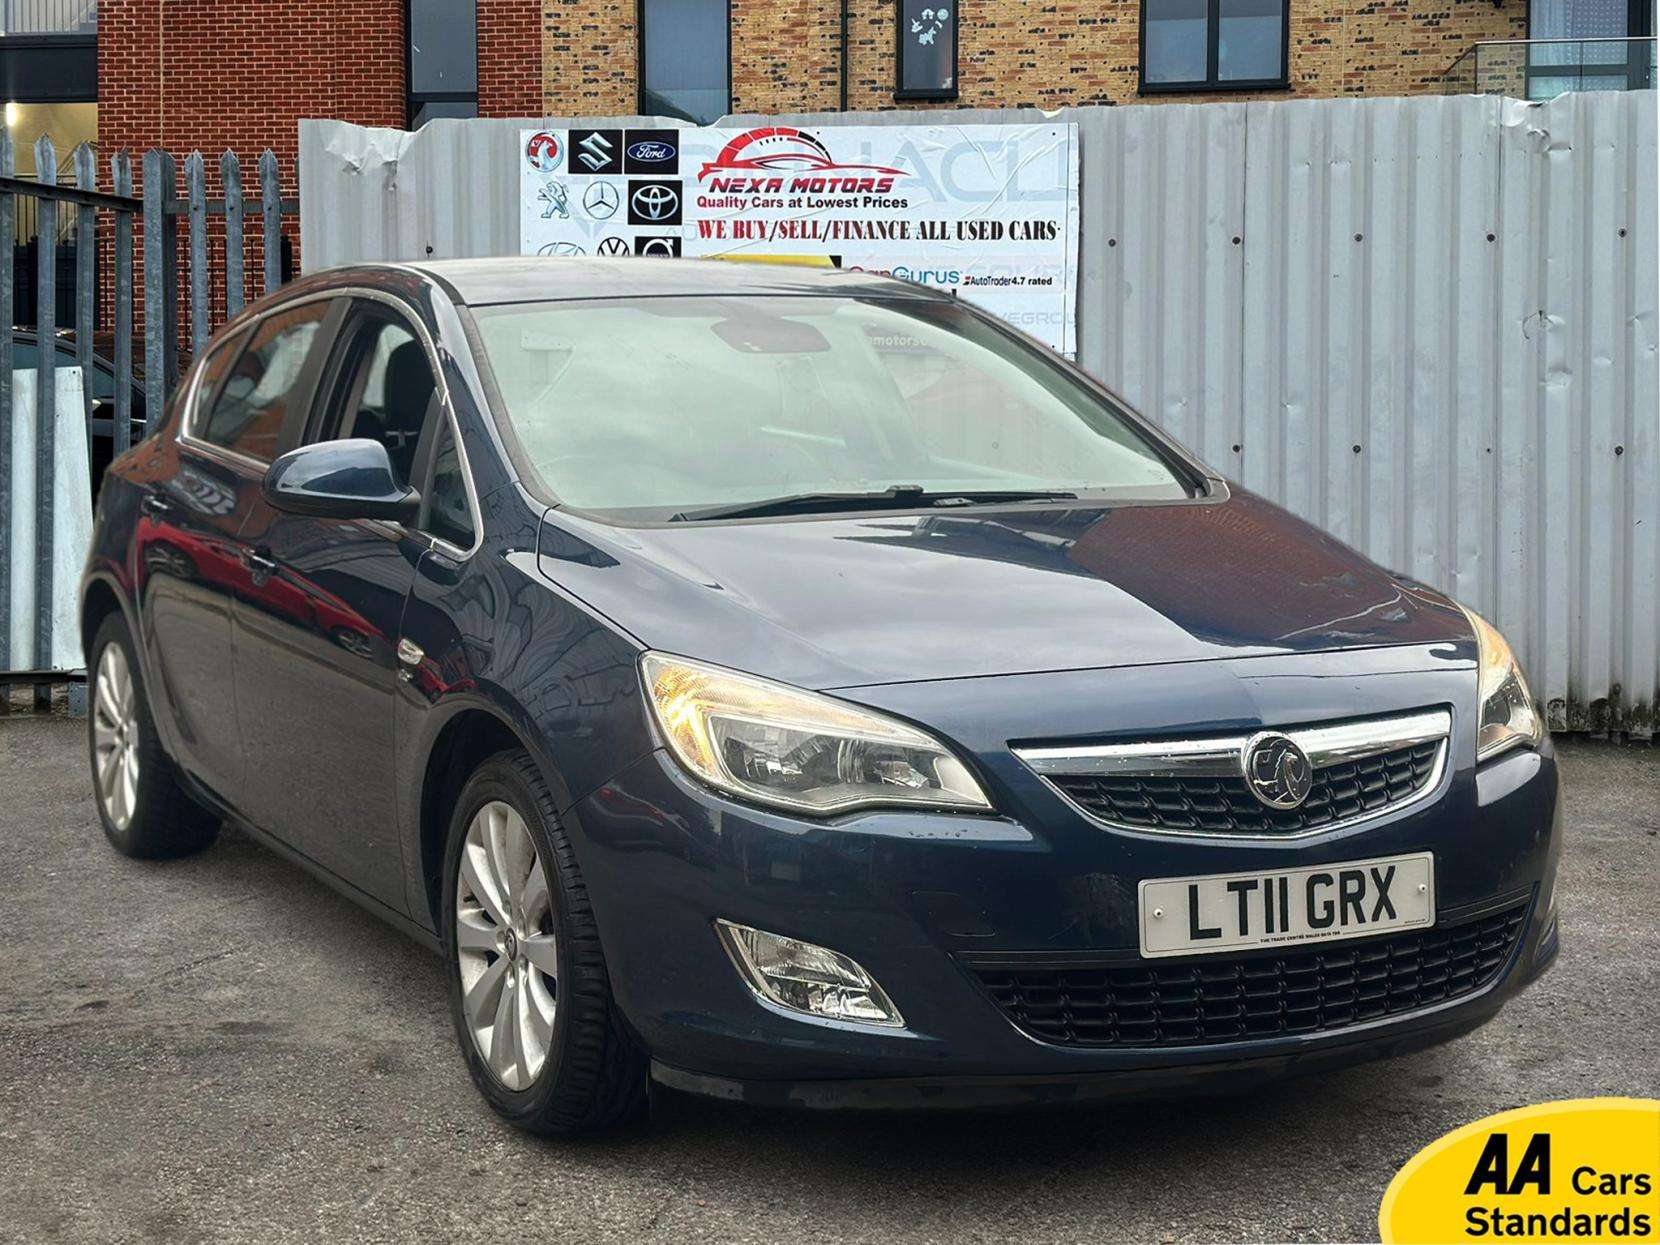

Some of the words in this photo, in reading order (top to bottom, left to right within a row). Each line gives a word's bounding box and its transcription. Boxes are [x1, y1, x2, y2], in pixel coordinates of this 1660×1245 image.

[635, 144, 667, 159] Ford
[709, 178, 784, 194] NEXA
[789, 178, 894, 194] MOTORS
[697, 196, 747, 210] Quality
[751, 196, 784, 208] Cars
[788, 197, 802, 208] at
[807, 196, 858, 208] Lowest
[863, 196, 908, 208] Prices
[698, 219, 727, 240] WE
[733, 219, 911, 242] BUY/SELL/FINANCE
[916, 220, 951, 241] ALL
[956, 220, 1004, 241] USED
[1008, 220, 1057, 241] CARS
[1028, 276, 1053, 285] rated
[1188, 877, 1289, 940] LT11
[1306, 865, 1397, 929] GRX
